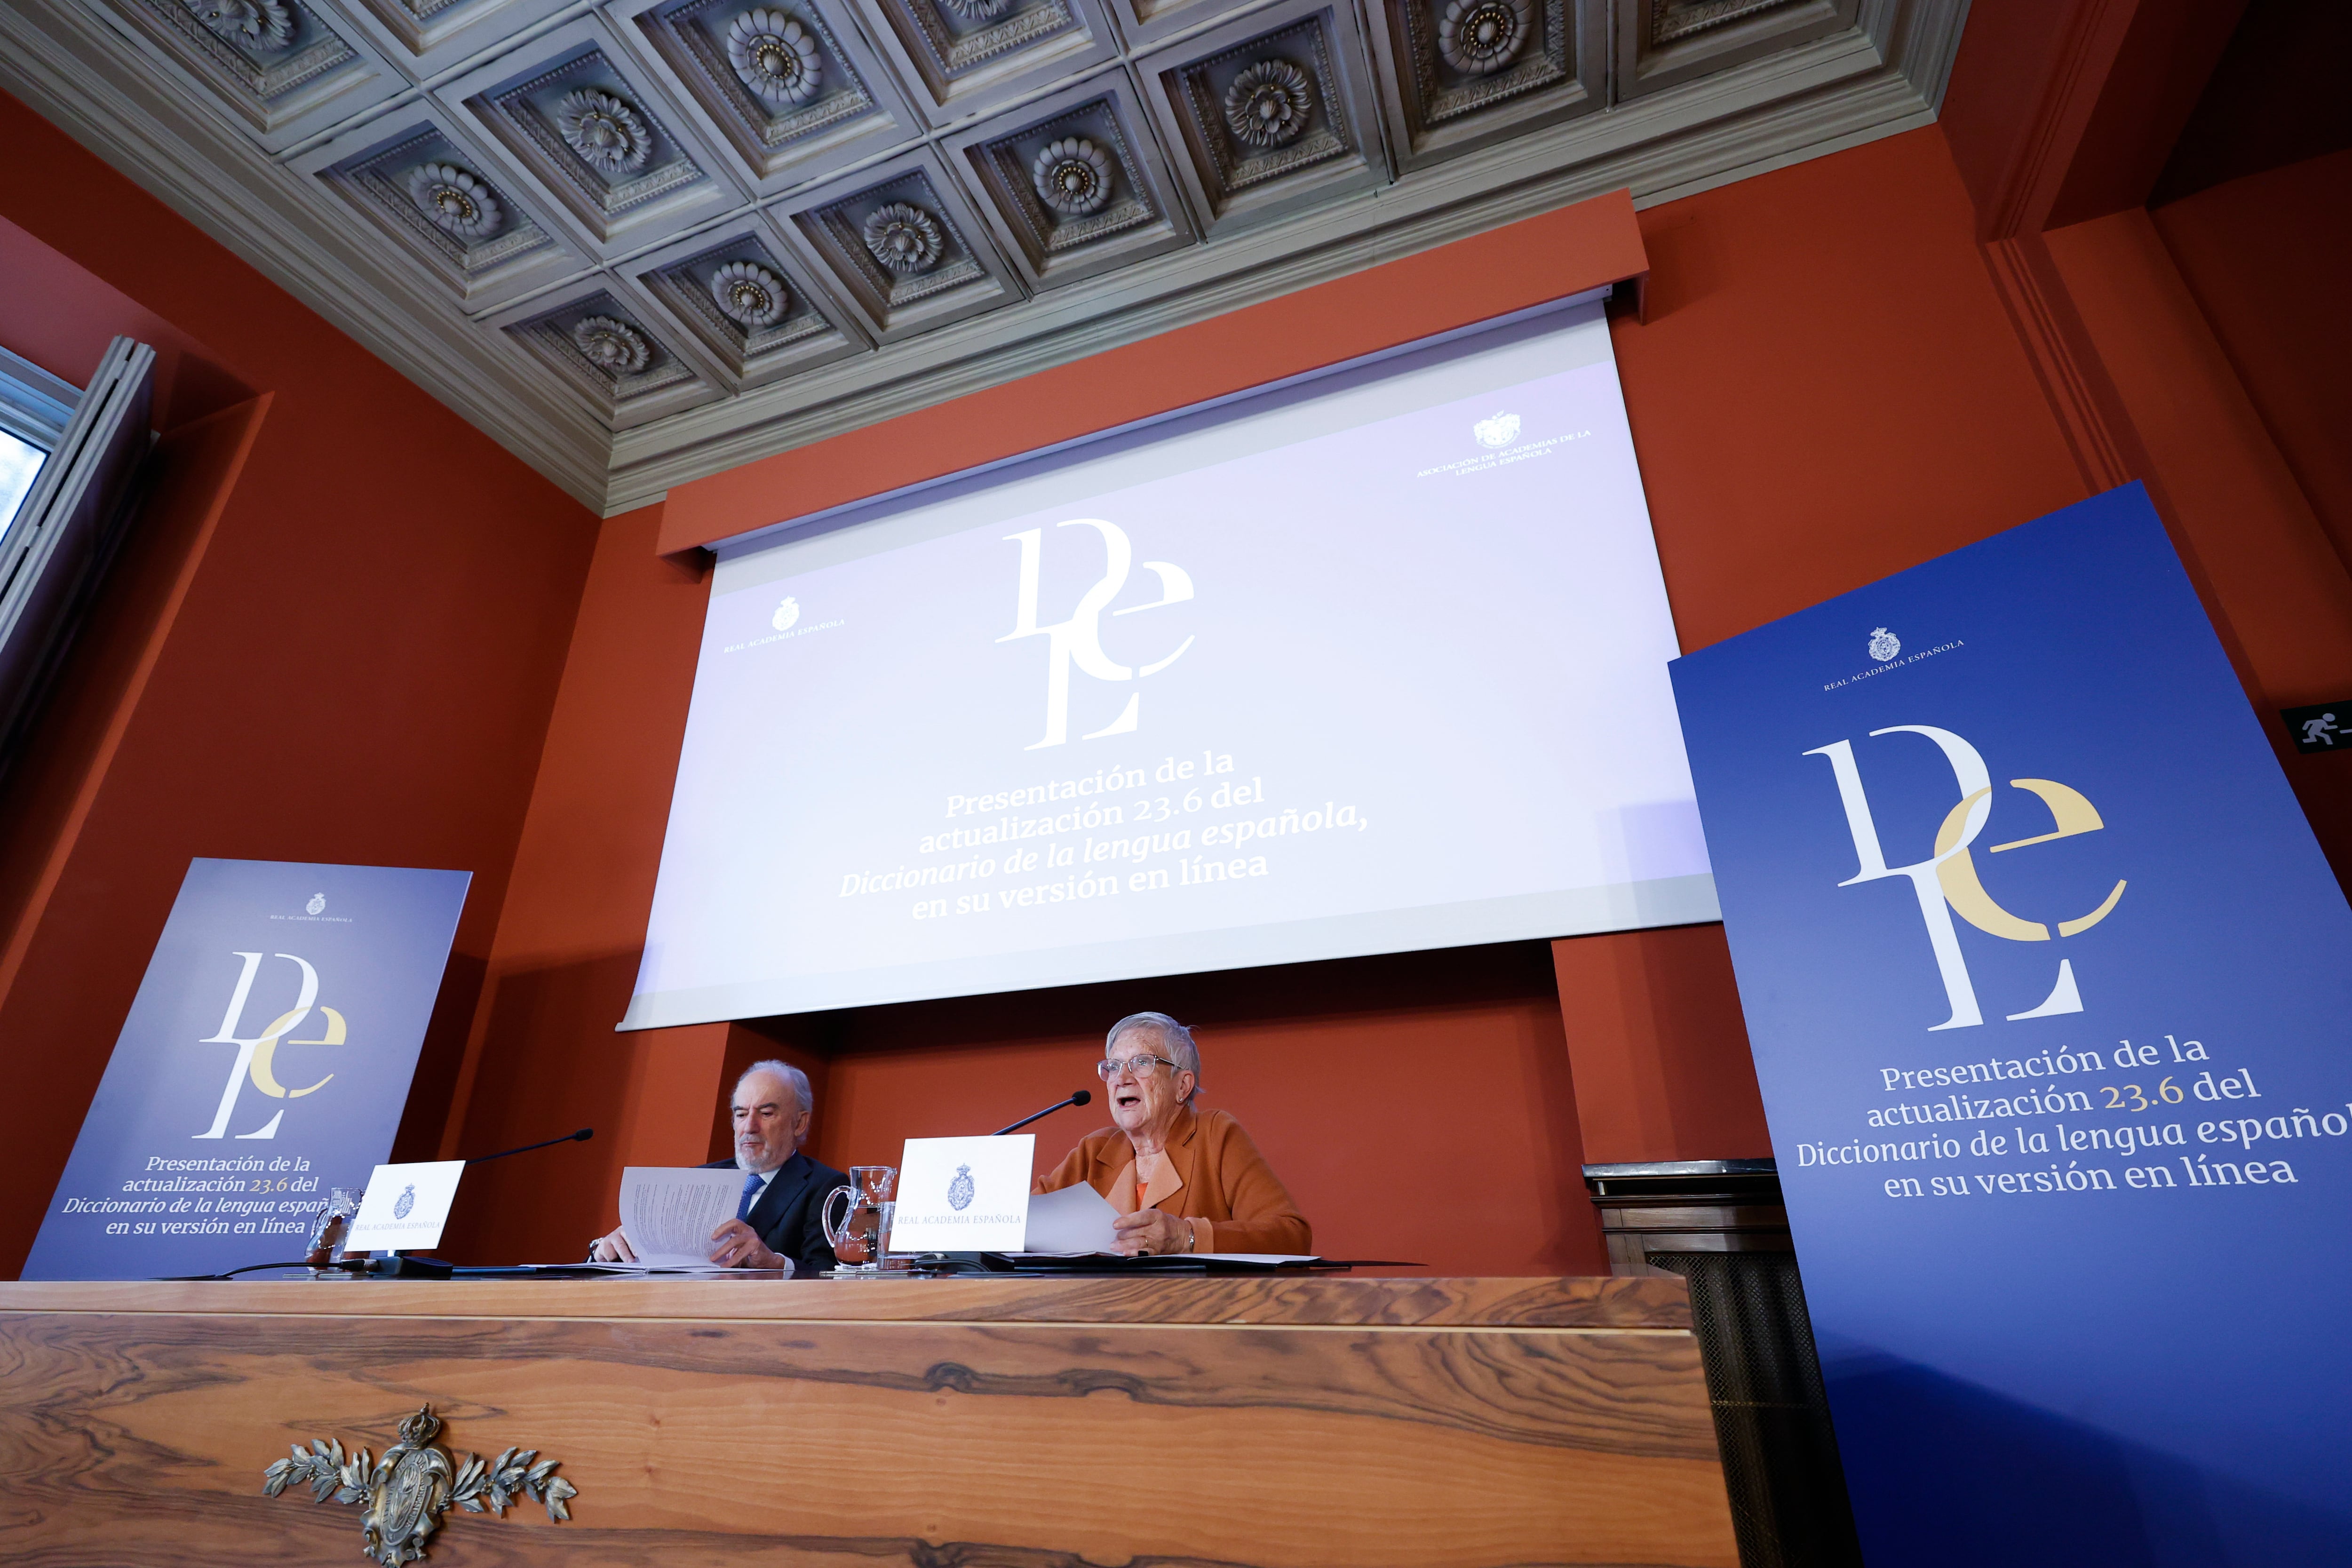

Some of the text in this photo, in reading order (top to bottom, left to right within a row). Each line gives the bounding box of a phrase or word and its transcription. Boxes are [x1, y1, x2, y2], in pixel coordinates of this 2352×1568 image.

[1417, 430, 1591, 478] ASOCIACIÓN DE ACADEMIAS DE LA
[1455, 447, 1552, 476] LENGUA ESPAÑOLA
[724, 619, 845, 653] REAL ACADEMIA ESPAÑOLA
[1824, 640, 1964, 691] REAL ACADEMIA ESPAÑOLA
[945, 750, 1235, 818] Presentación de la
[919, 776, 1265, 853] actualización 23.6 del
[839, 801, 1367, 897] Diccionario de la lengua española,
[913, 854, 1269, 920] en su versión en línea
[1880, 1035, 2210, 1091] Presentación de la
[1867, 1068, 2262, 1127] actualización 23.6 del
[1796, 1103, 2352, 1167] Diccionario de la lengua españo
[122, 1175, 319, 1194] actualización 23.6 del
[144, 1155, 310, 1171] Presentación de la
[1884, 1153, 2299, 1198] en su versión en línea
[61, 1197, 167, 1213] Diccionario
[169, 1197, 192, 1213] de
[194, 1197, 213, 1213] la
[215, 1197, 276, 1217] lengua
[106, 1217, 305, 1234] en su versión en línea
[922, 1216, 969, 1224] ACADEMIA
[974, 1214, 1020, 1223] ESPAÑOLA
